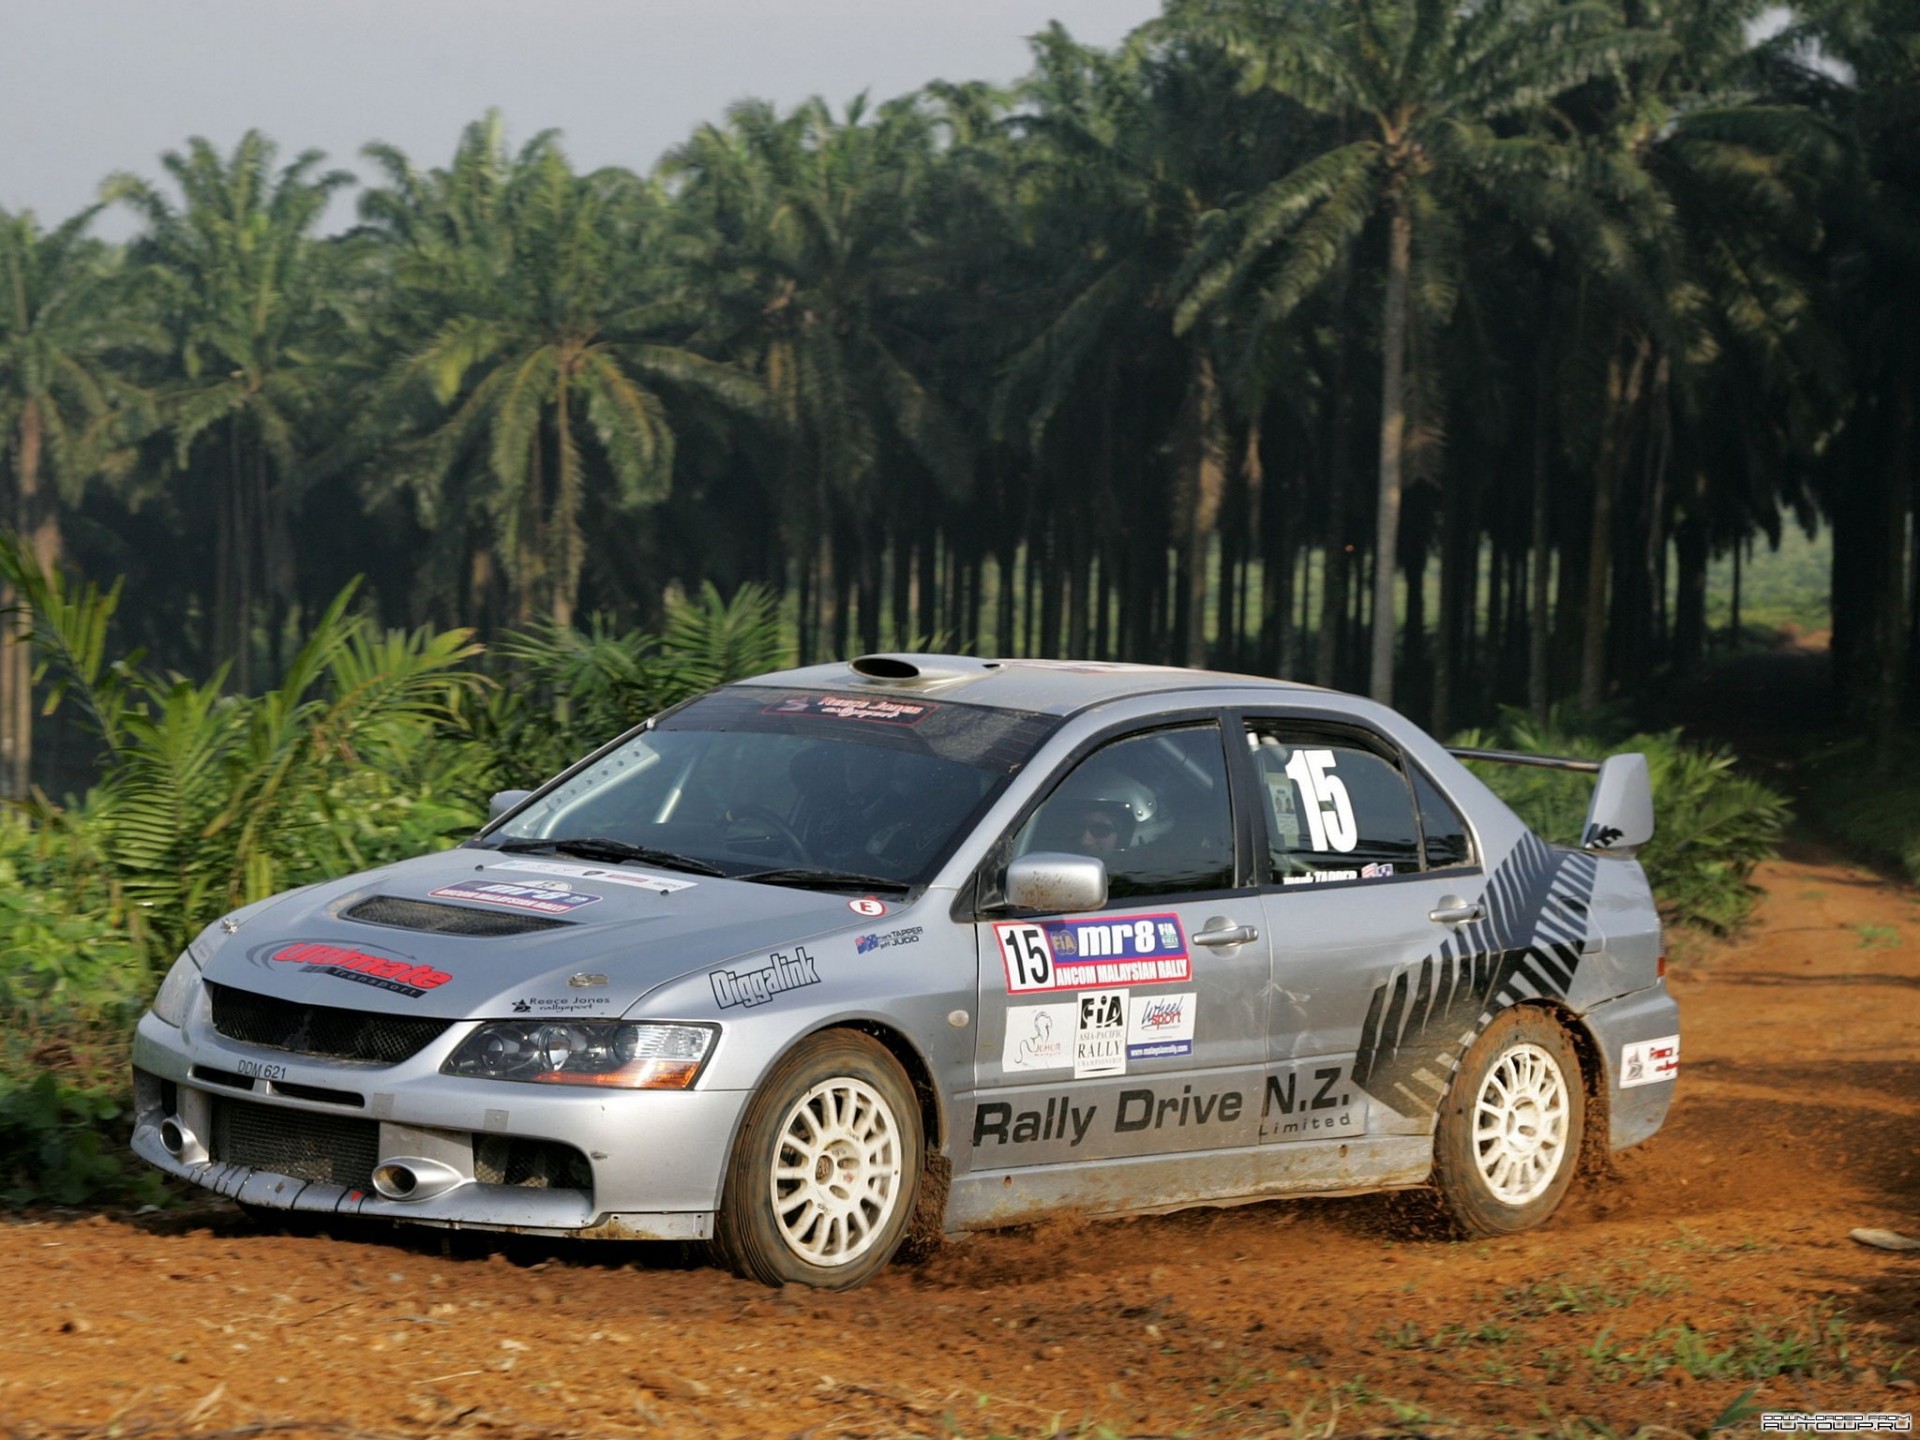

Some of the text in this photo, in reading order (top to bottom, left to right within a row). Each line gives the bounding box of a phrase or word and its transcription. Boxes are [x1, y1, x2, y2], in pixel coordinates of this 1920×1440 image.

[1285, 749, 1358, 852] 15
[860, 901, 873, 913] E
[891, 926, 923, 938] TAPPER
[891, 935, 919, 947] JUDD
[1077, 920, 1156, 957] mr8
[273, 942, 453, 989] Ultimate
[1005, 929, 1049, 985] 15
[709, 946, 822, 1010] Diggalink
[1056, 959, 1187, 986] ANCOM MALAYSIAN RALLY
[529, 996, 610, 1005] Reece Jones
[1152, 1011, 1181, 1030] sport
[1078, 1041, 1122, 1059] RALLY
[238, 1059, 287, 1080] DDM 621
[973, 1067, 1350, 1147] Rally Drive N.Z.
[1258, 1112, 1351, 1138] Limited
